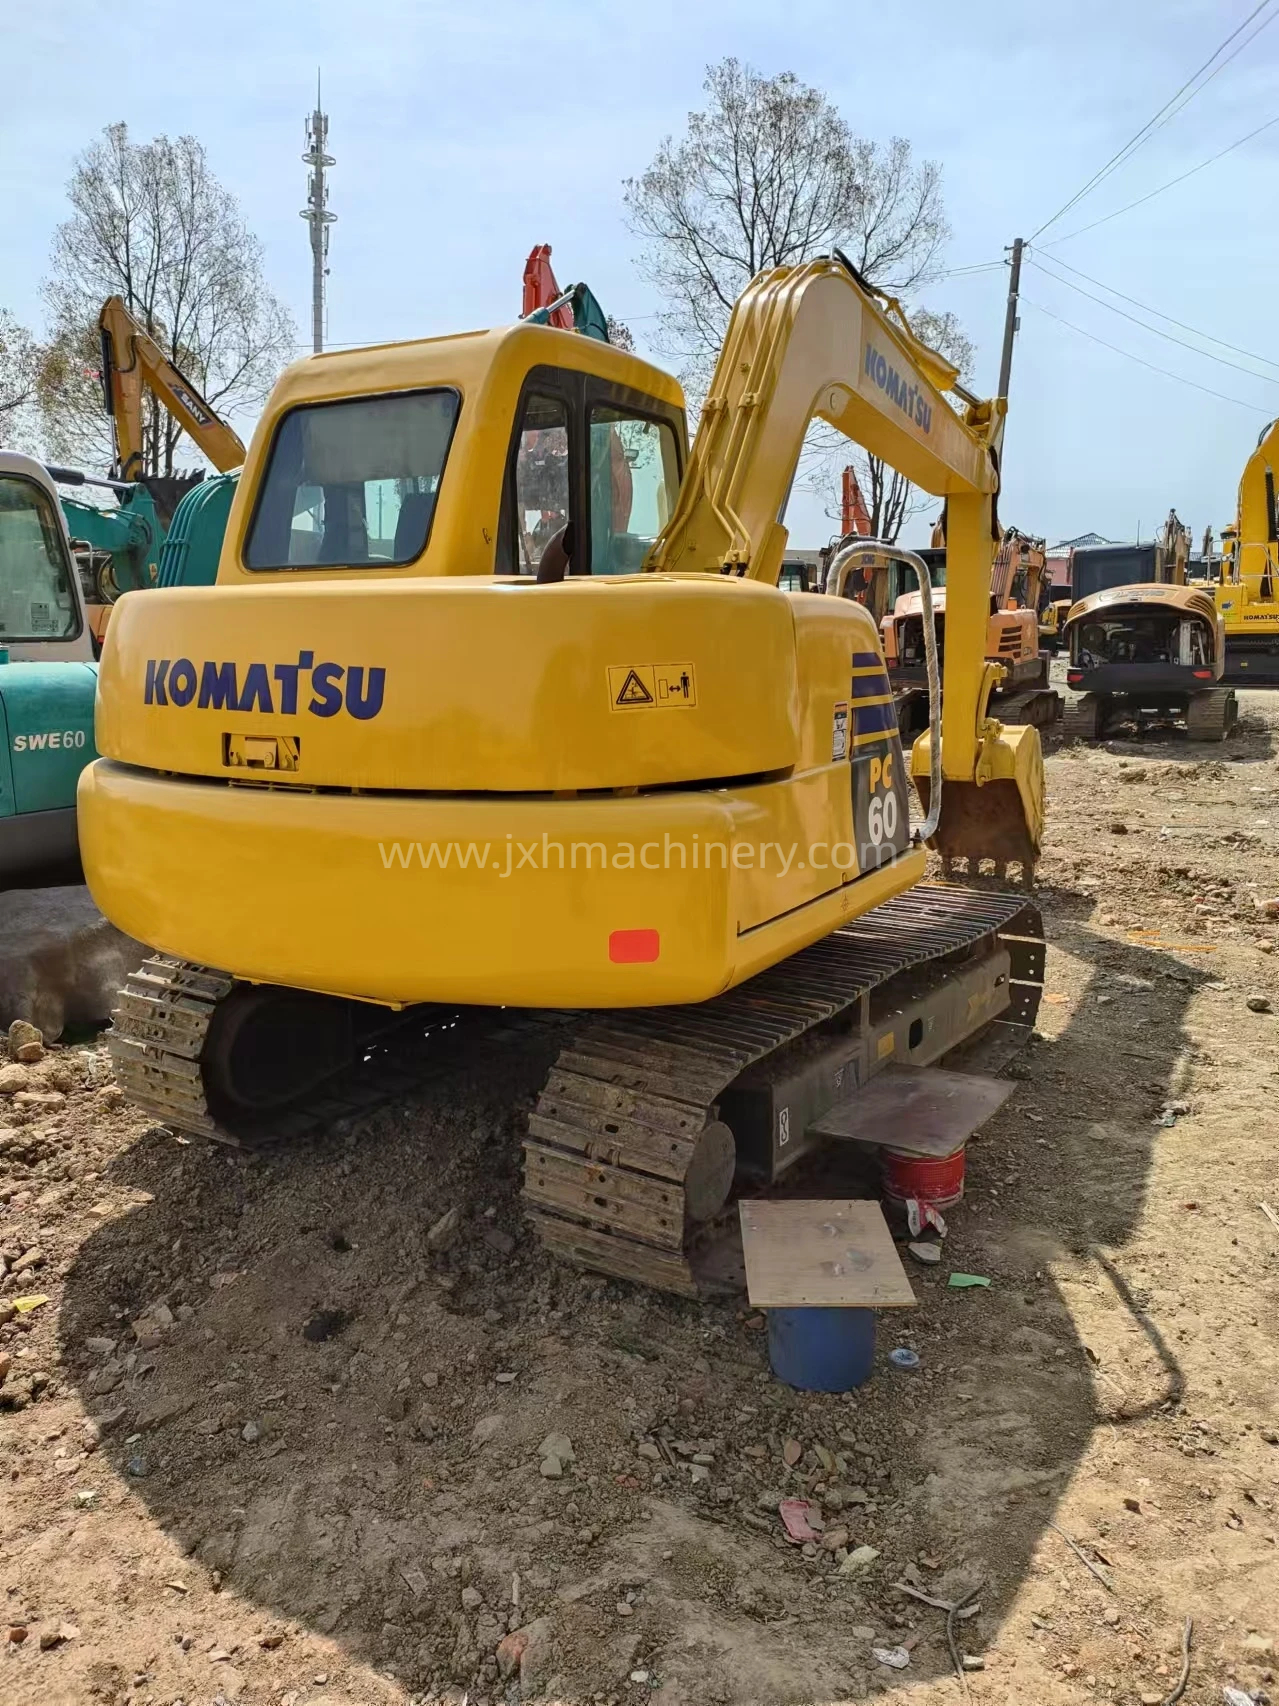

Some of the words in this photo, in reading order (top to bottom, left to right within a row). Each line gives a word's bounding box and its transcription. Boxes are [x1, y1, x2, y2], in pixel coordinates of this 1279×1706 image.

[865, 343, 932, 434] KOMATSU
[144, 650, 386, 720] KOMATSU
[13, 730, 86, 752] SWE60
[869, 753, 893, 794] PC
[868, 791, 898, 846] 60
